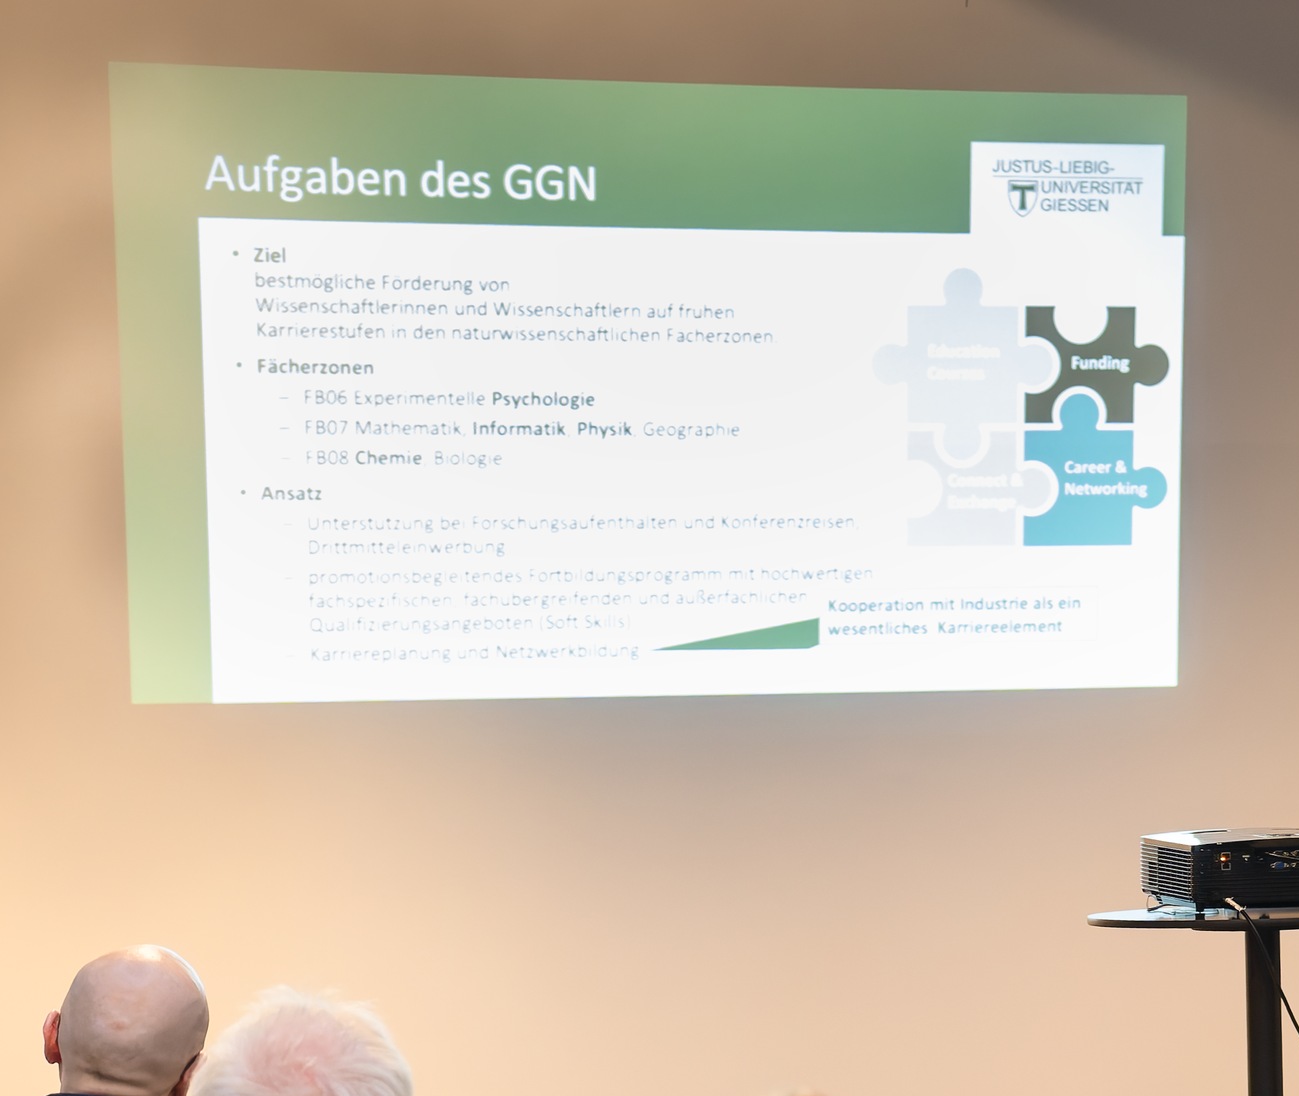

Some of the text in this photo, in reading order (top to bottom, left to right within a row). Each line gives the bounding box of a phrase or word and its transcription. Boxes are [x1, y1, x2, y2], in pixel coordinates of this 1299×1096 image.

[992, 160, 1115, 174] JUSTUS-LIEBIG-
[205, 154, 596, 202] Aufgaben des GGN
[1041, 198, 1109, 212] GIESSEN
[254, 247, 286, 263] Ziel
[255, 272, 376, 293] bestmögliche
[479, 280, 510, 292] von
[255, 298, 448, 315] Wissenschaftlerinnen
[455, 301, 488, 316] und
[493, 302, 641, 319] Wissenschaftlern
[647, 304, 673, 319] auf
[256, 322, 385, 339] Karrierestufen
[391, 324, 407, 339] in
[413, 325, 446, 340] den
[451, 327, 660, 342] naturwissenschaftlichen
[257, 358, 374, 375] Fächerzonen
[1071, 355, 1130, 374] Funding
[304, 389, 595, 410] FB06 Experimentelle Psychologie
[304, 419, 349, 435] FB07
[643, 421, 741, 440] Geographie
[434, 451, 502, 468] Biologie
[1064, 460, 1127, 474] Career &
[261, 486, 322, 501] Ansatz
[1064, 482, 1148, 498] Networking
[440, 517, 466, 531] bei
[472, 515, 677, 533] Forschungsaufenthalten
[684, 516, 715, 529] und
[308, 539, 505, 557] Drittmitteleinwerbung
[308, 567, 873, 587] promotionsbegleitendes Fortbildungsprogramm mit hochwertigen
[639, 591, 670, 605] und
[828, 597, 1082, 613] Kooperation mit Industrie als ein
[310, 617, 533, 635] Qualifizierungsangeboten
[828, 620, 1063, 636] wesentliches Karriereelement
[311, 644, 639, 663] Karriereplanung und Netzwerkbildung
